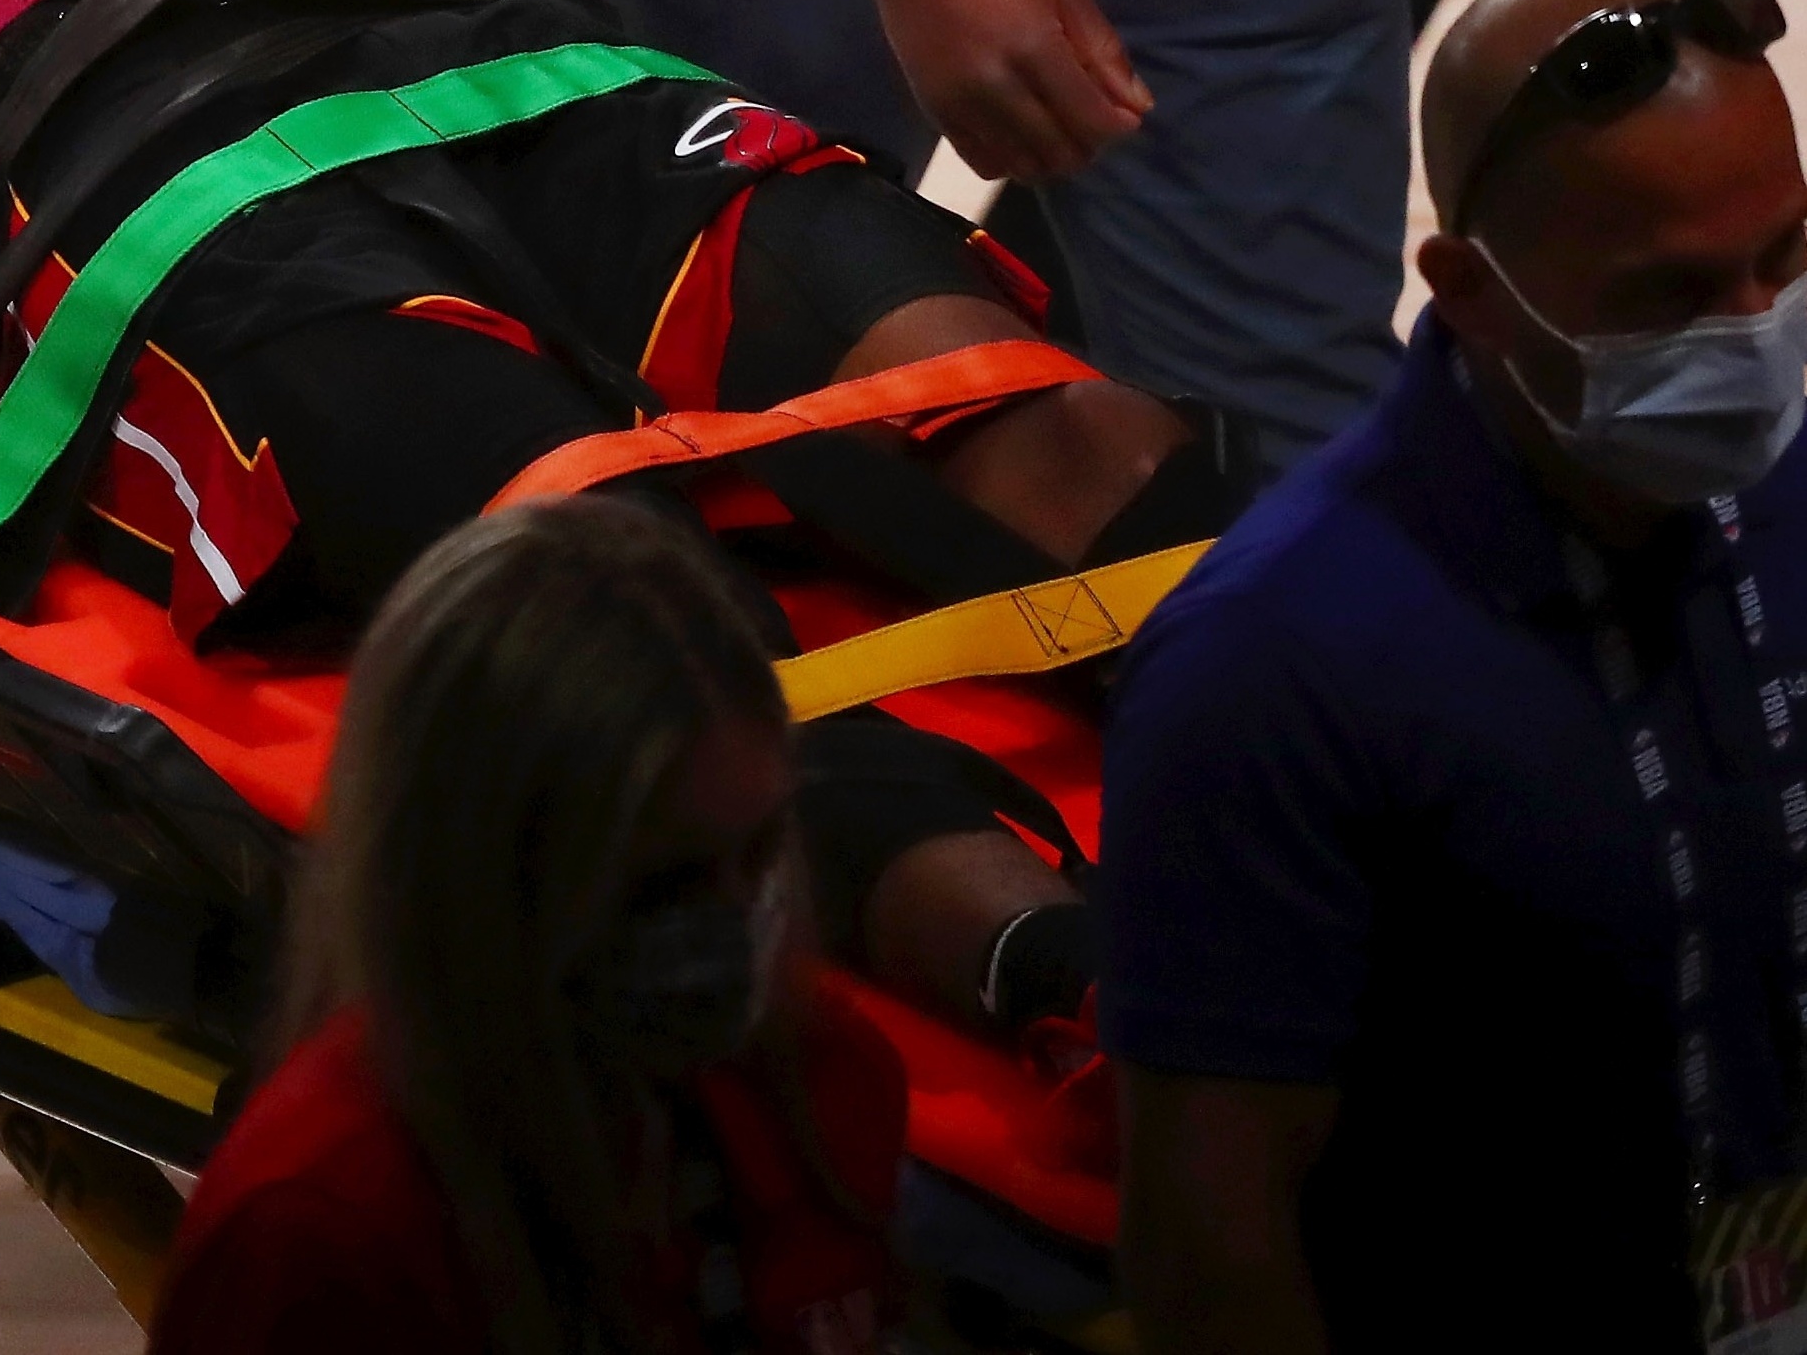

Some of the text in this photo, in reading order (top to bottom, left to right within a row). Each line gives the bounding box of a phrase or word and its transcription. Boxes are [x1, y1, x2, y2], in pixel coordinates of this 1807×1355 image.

[1736, 575, 1764, 626] NBA
[1758, 677, 1791, 731] NBA
[1632, 746, 1670, 800] NBA
